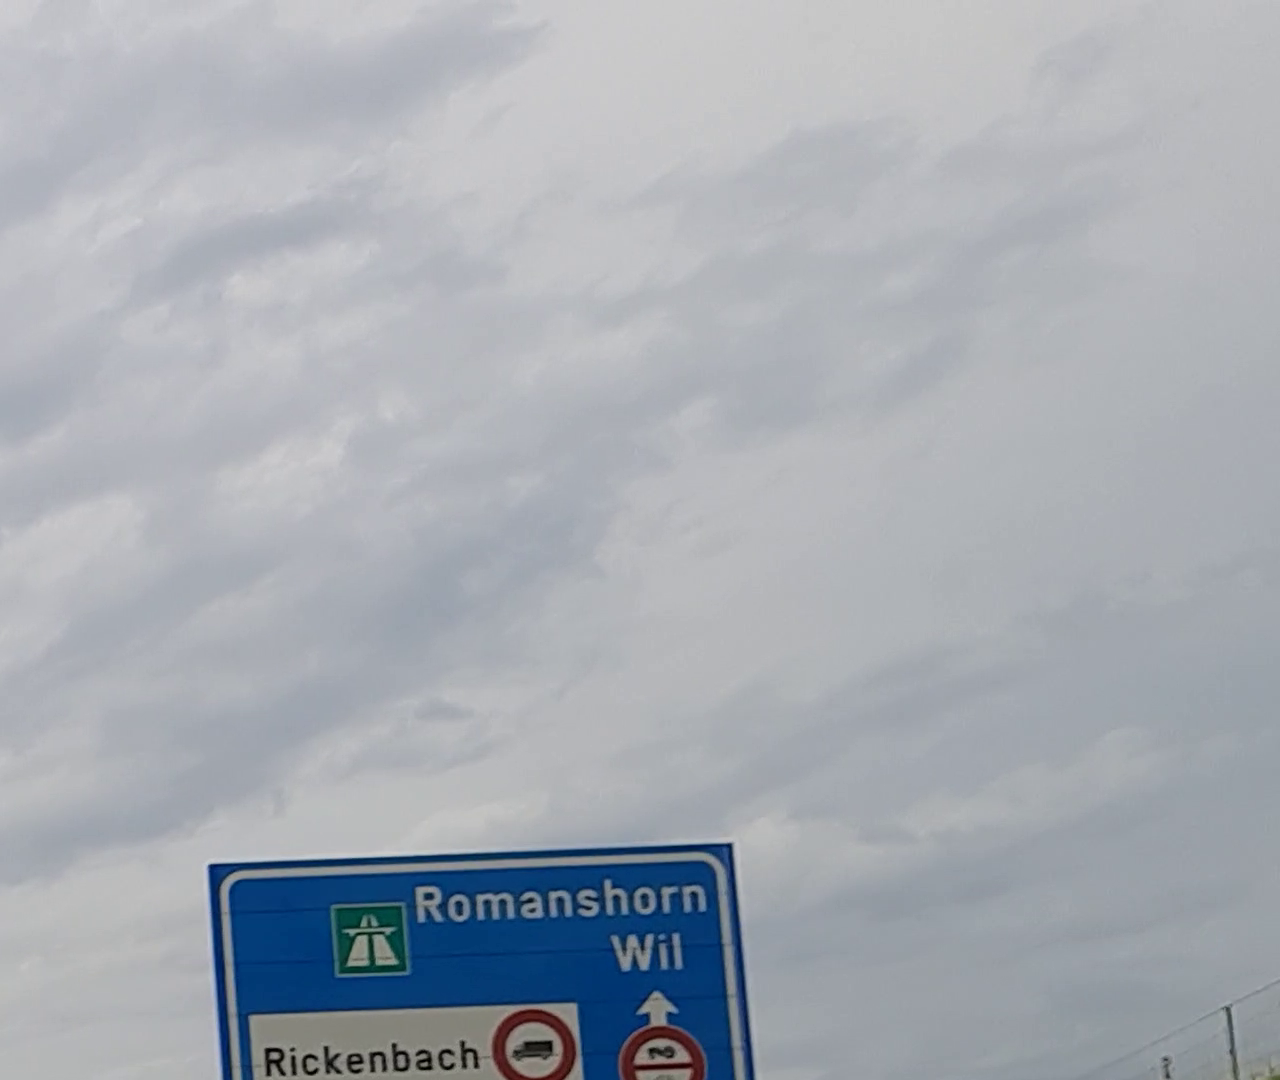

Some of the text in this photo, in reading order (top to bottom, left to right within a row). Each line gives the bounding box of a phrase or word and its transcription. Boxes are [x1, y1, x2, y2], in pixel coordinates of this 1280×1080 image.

[415, 879, 709, 925] Romanshorn
[610, 932, 684, 973] Wil
[262, 1040, 482, 1079] Rickenbach
